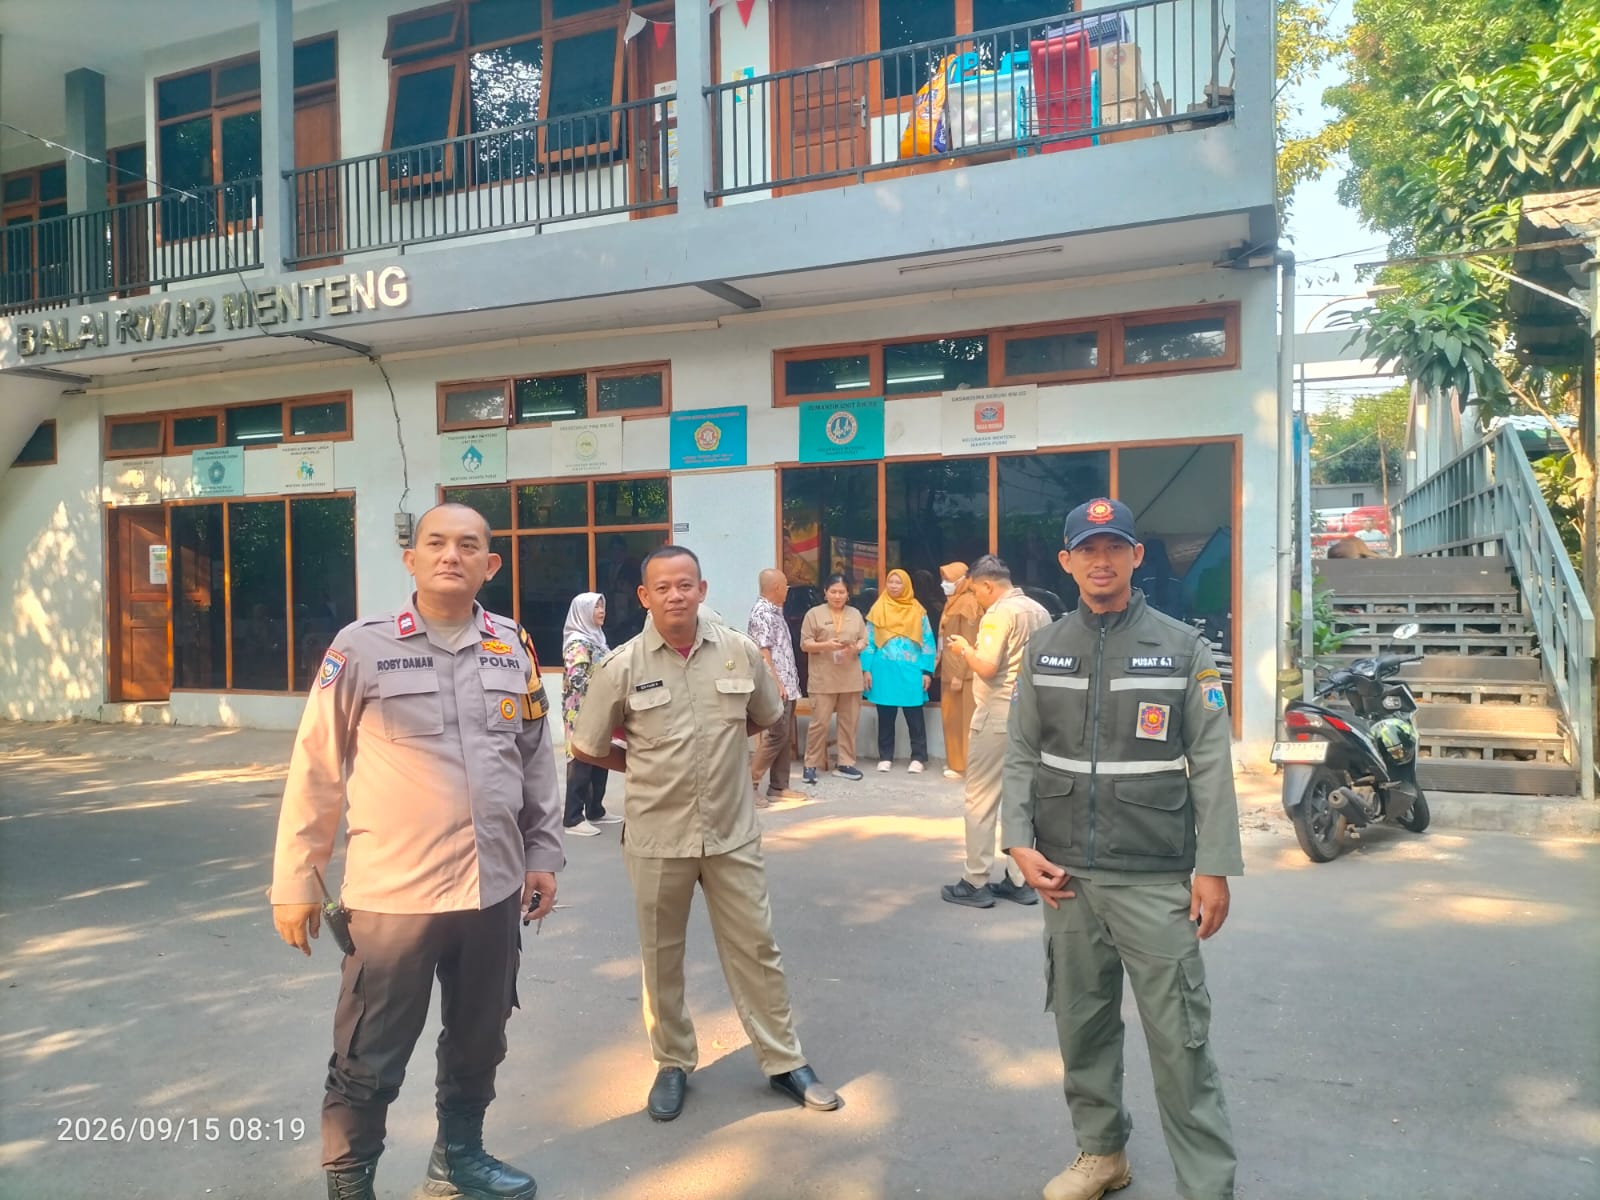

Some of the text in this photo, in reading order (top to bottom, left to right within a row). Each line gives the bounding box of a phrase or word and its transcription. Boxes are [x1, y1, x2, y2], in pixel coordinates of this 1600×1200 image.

[17, 266, 409, 357] BALAI RW.02 MENTENG
[377, 658, 401, 671] ROBY
[479, 656, 520, 669] POLRI
[1041, 655, 1073, 667] OMAN
[1132, 657, 1158, 667] PUSAT
